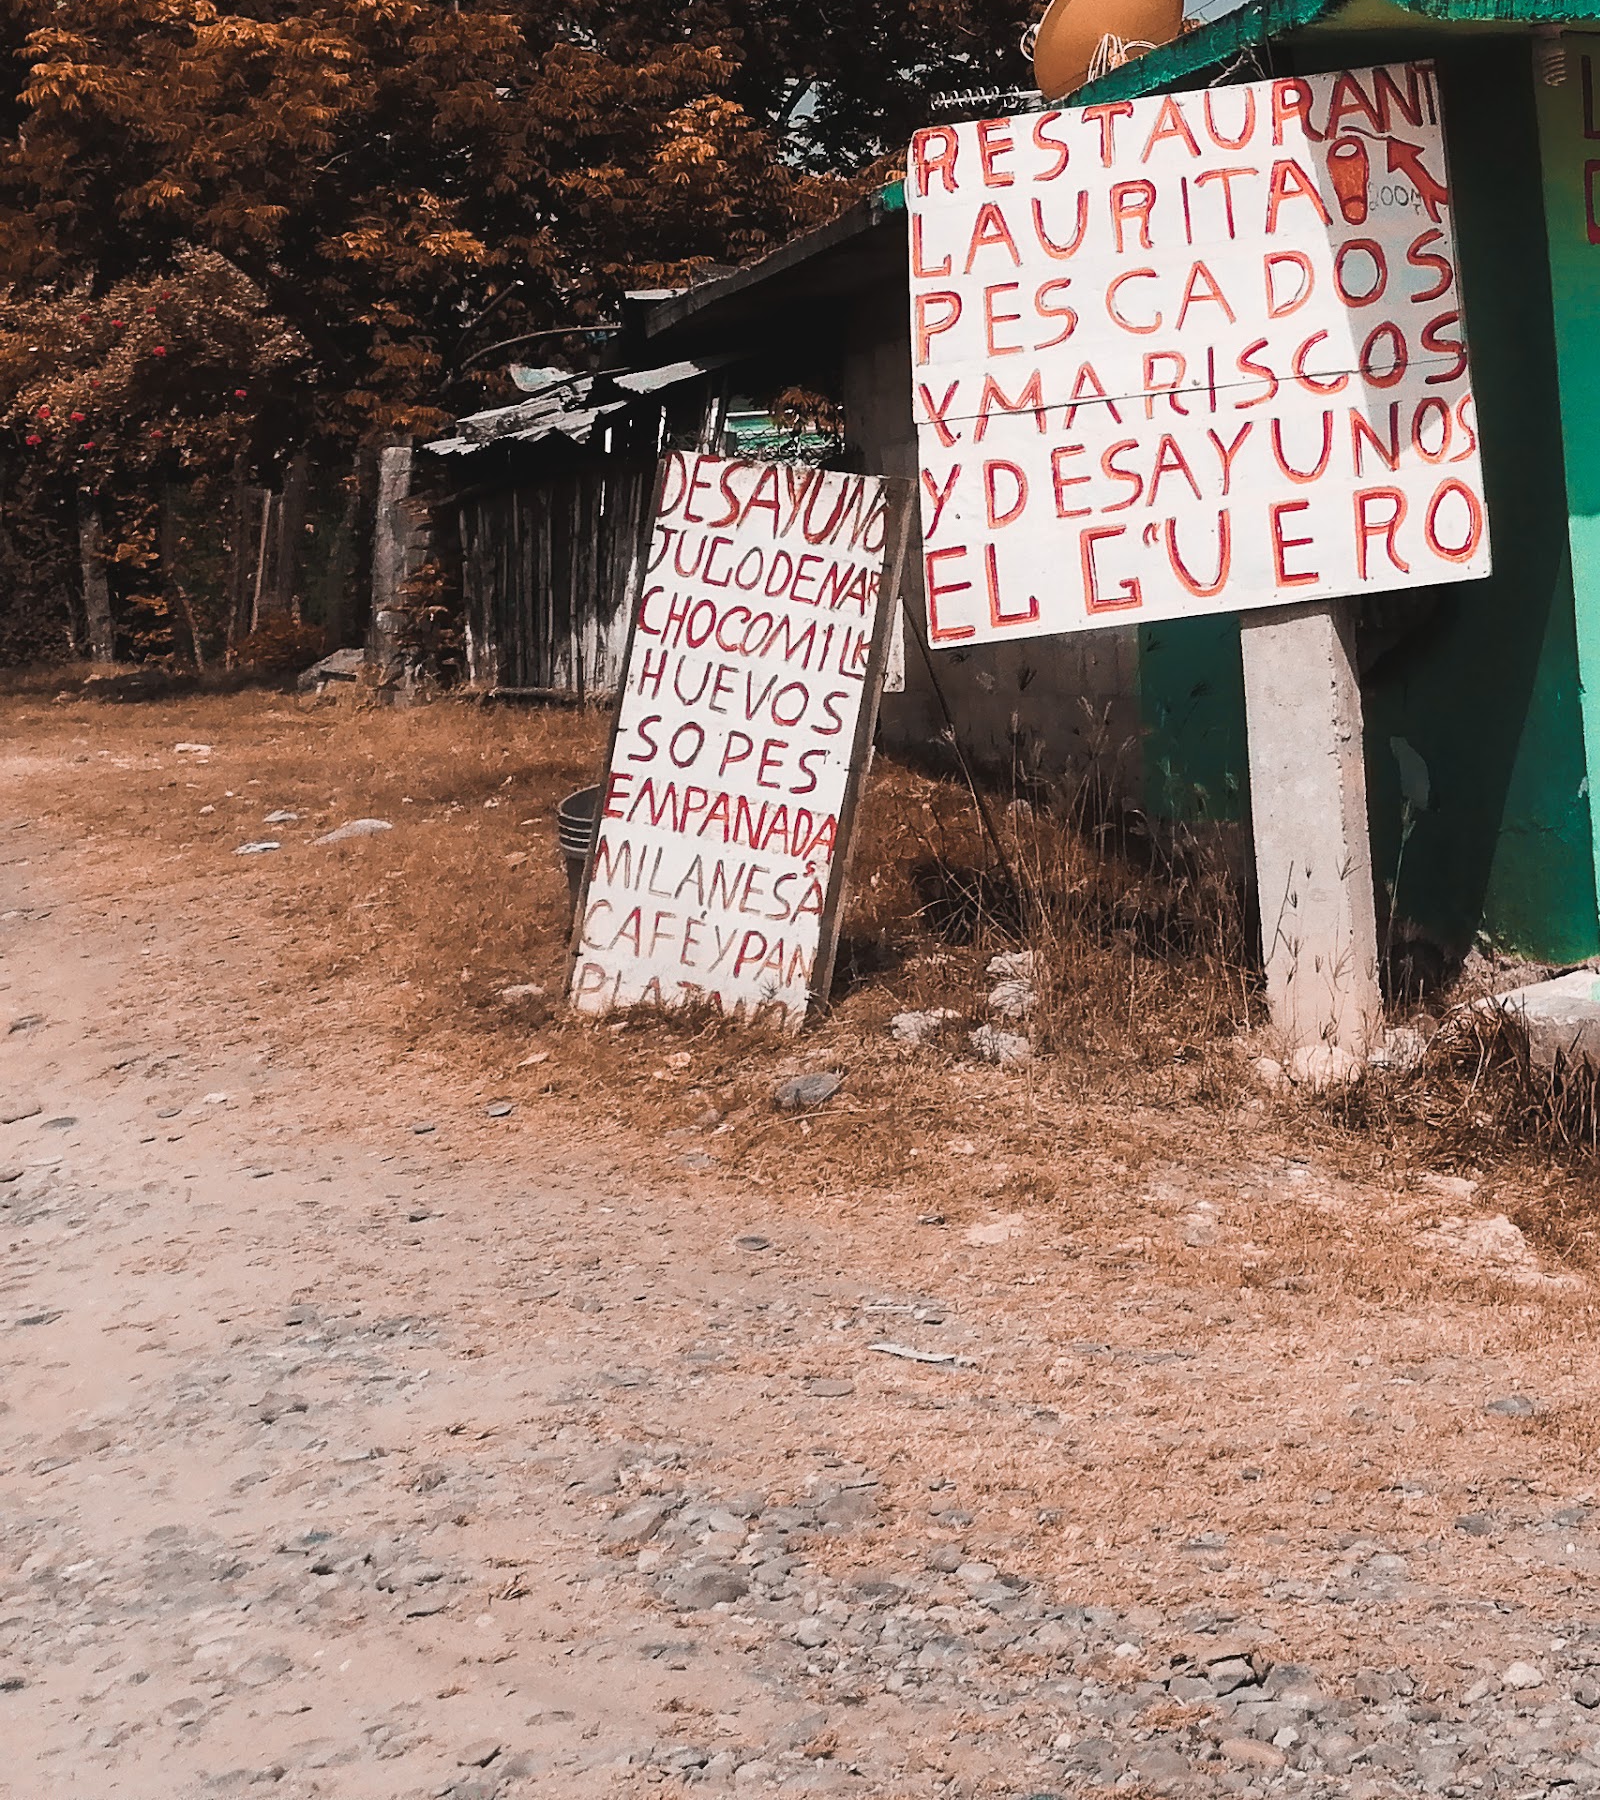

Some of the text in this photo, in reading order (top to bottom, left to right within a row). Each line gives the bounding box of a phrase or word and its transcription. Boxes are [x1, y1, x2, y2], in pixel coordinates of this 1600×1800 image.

[912, 62, 1437, 196] RESTAURANT
[911, 158, 1332, 278] LAURITA
[914, 228, 1454, 367] PESCADOS
[656, 450, 888, 553] DESAYUNO
[637, 585, 871, 681] CHOCOMILK
[924, 543, 1040, 642] EL
[637, 648, 850, 736] HUEVOS
[627, 715, 831, 794] SOPES
[591, 834, 825, 925] MILANESA
